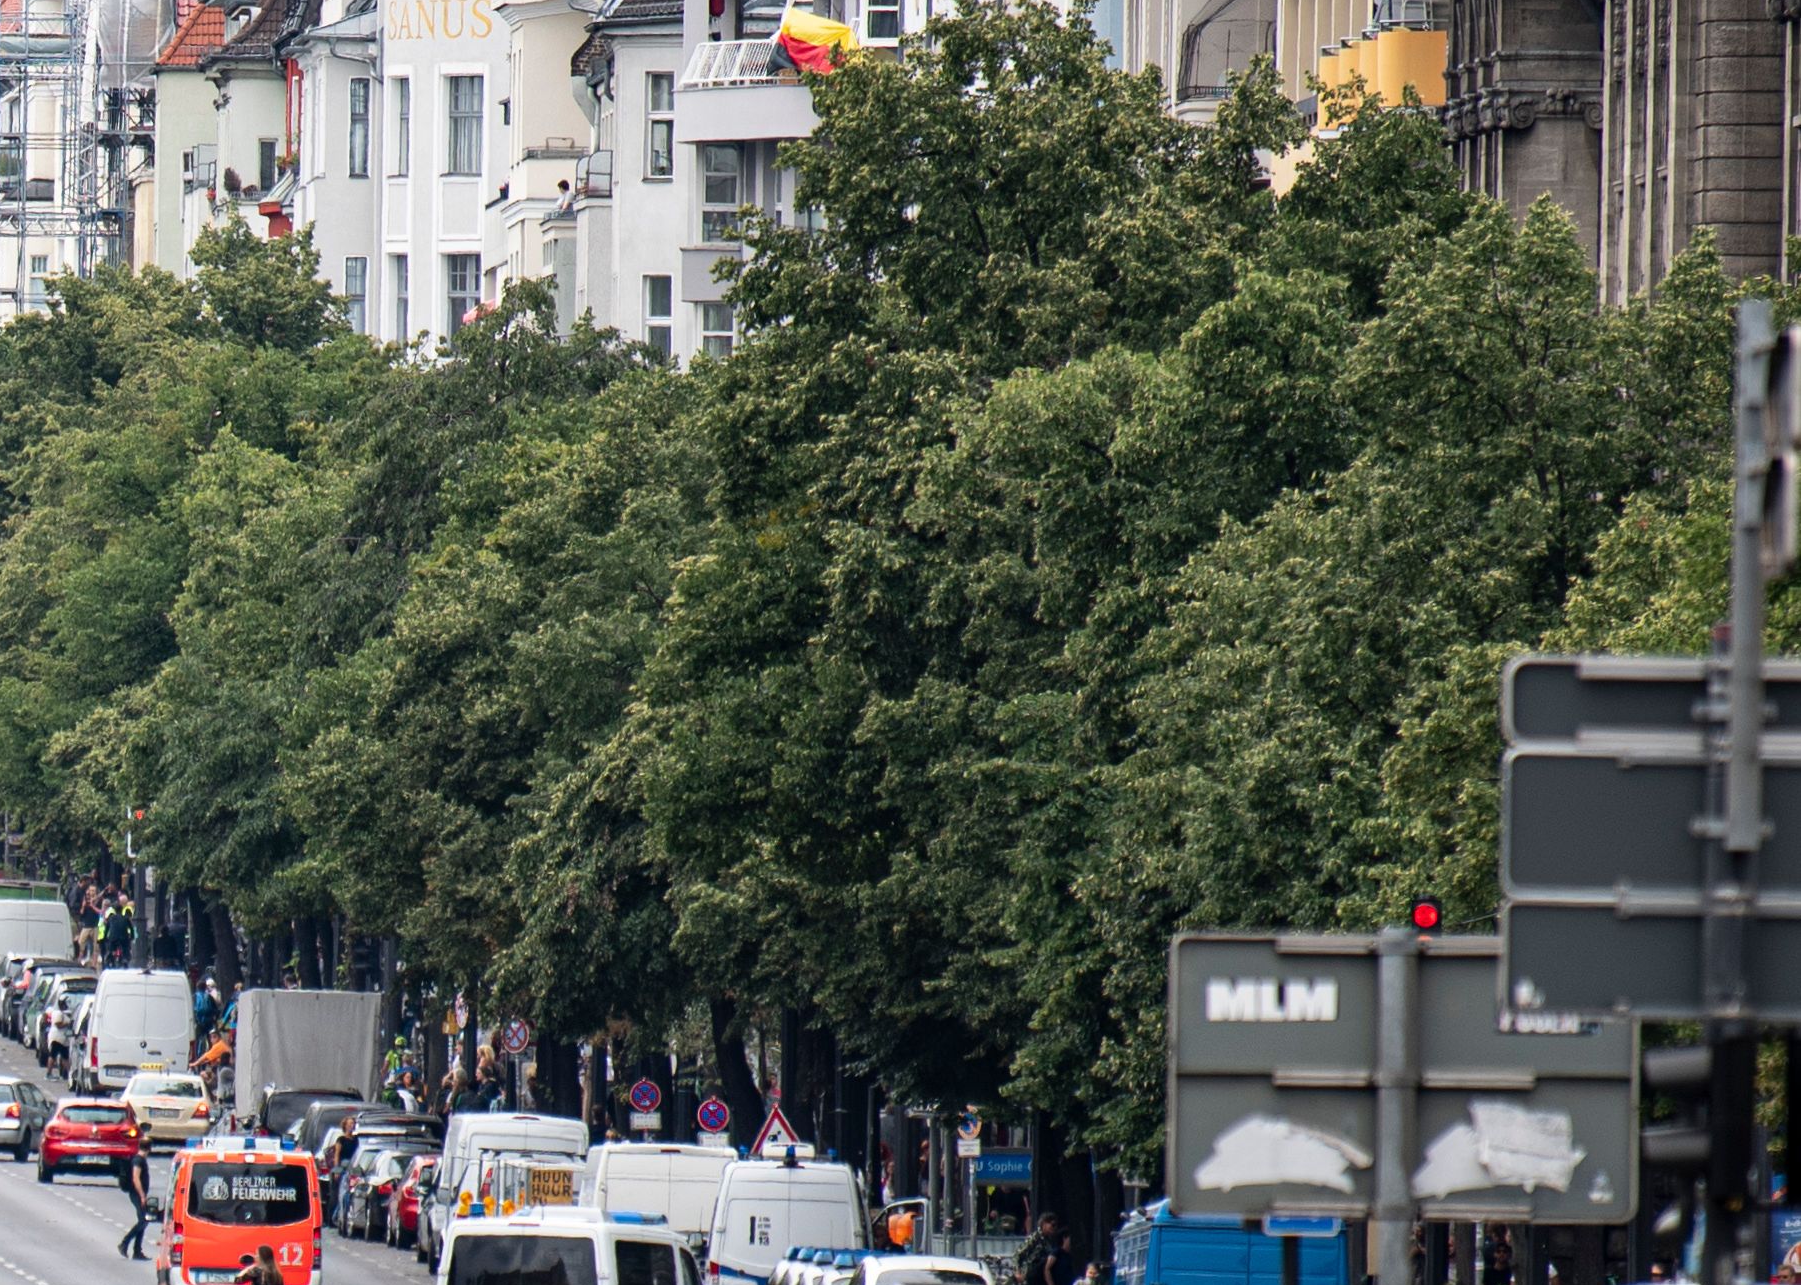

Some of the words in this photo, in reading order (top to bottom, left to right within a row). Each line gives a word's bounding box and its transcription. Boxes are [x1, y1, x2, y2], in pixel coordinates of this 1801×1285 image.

[1206, 978, 1339, 1022] MLM
[988, 1160, 1024, 1174] Sophie
[232, 1176, 276, 1187] BERLINER
[532, 1170, 572, 1183] HUUN
[231, 1187, 297, 1203] FEUERWEHR
[532, 1184, 571, 1197] HUUR
[279, 1246, 303, 1266] 12
